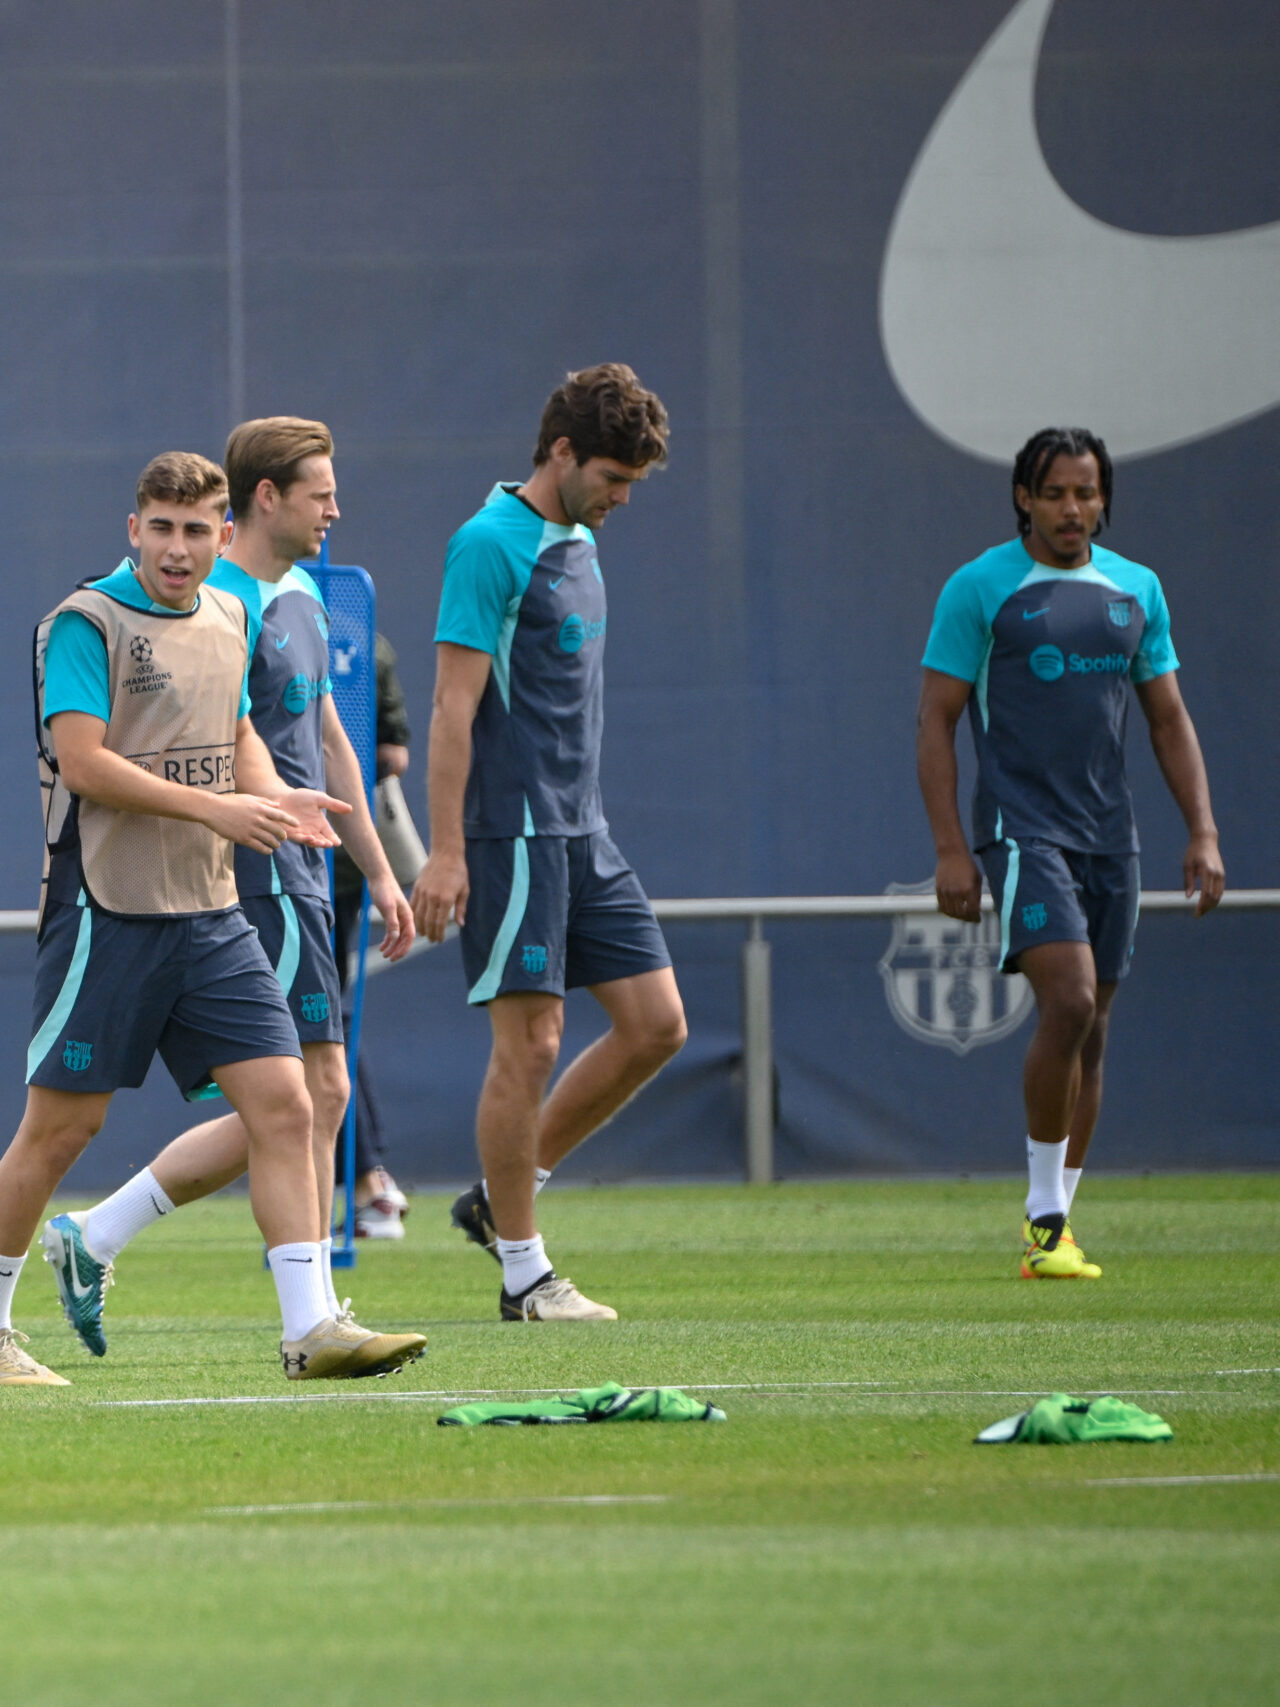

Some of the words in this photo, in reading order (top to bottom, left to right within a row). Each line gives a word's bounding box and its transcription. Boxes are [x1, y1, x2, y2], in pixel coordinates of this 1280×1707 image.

[1068, 652, 1131, 675] Spotify
[122, 672, 172, 688] CHAMPIONS
[130, 682, 167, 694] LEAGUE
